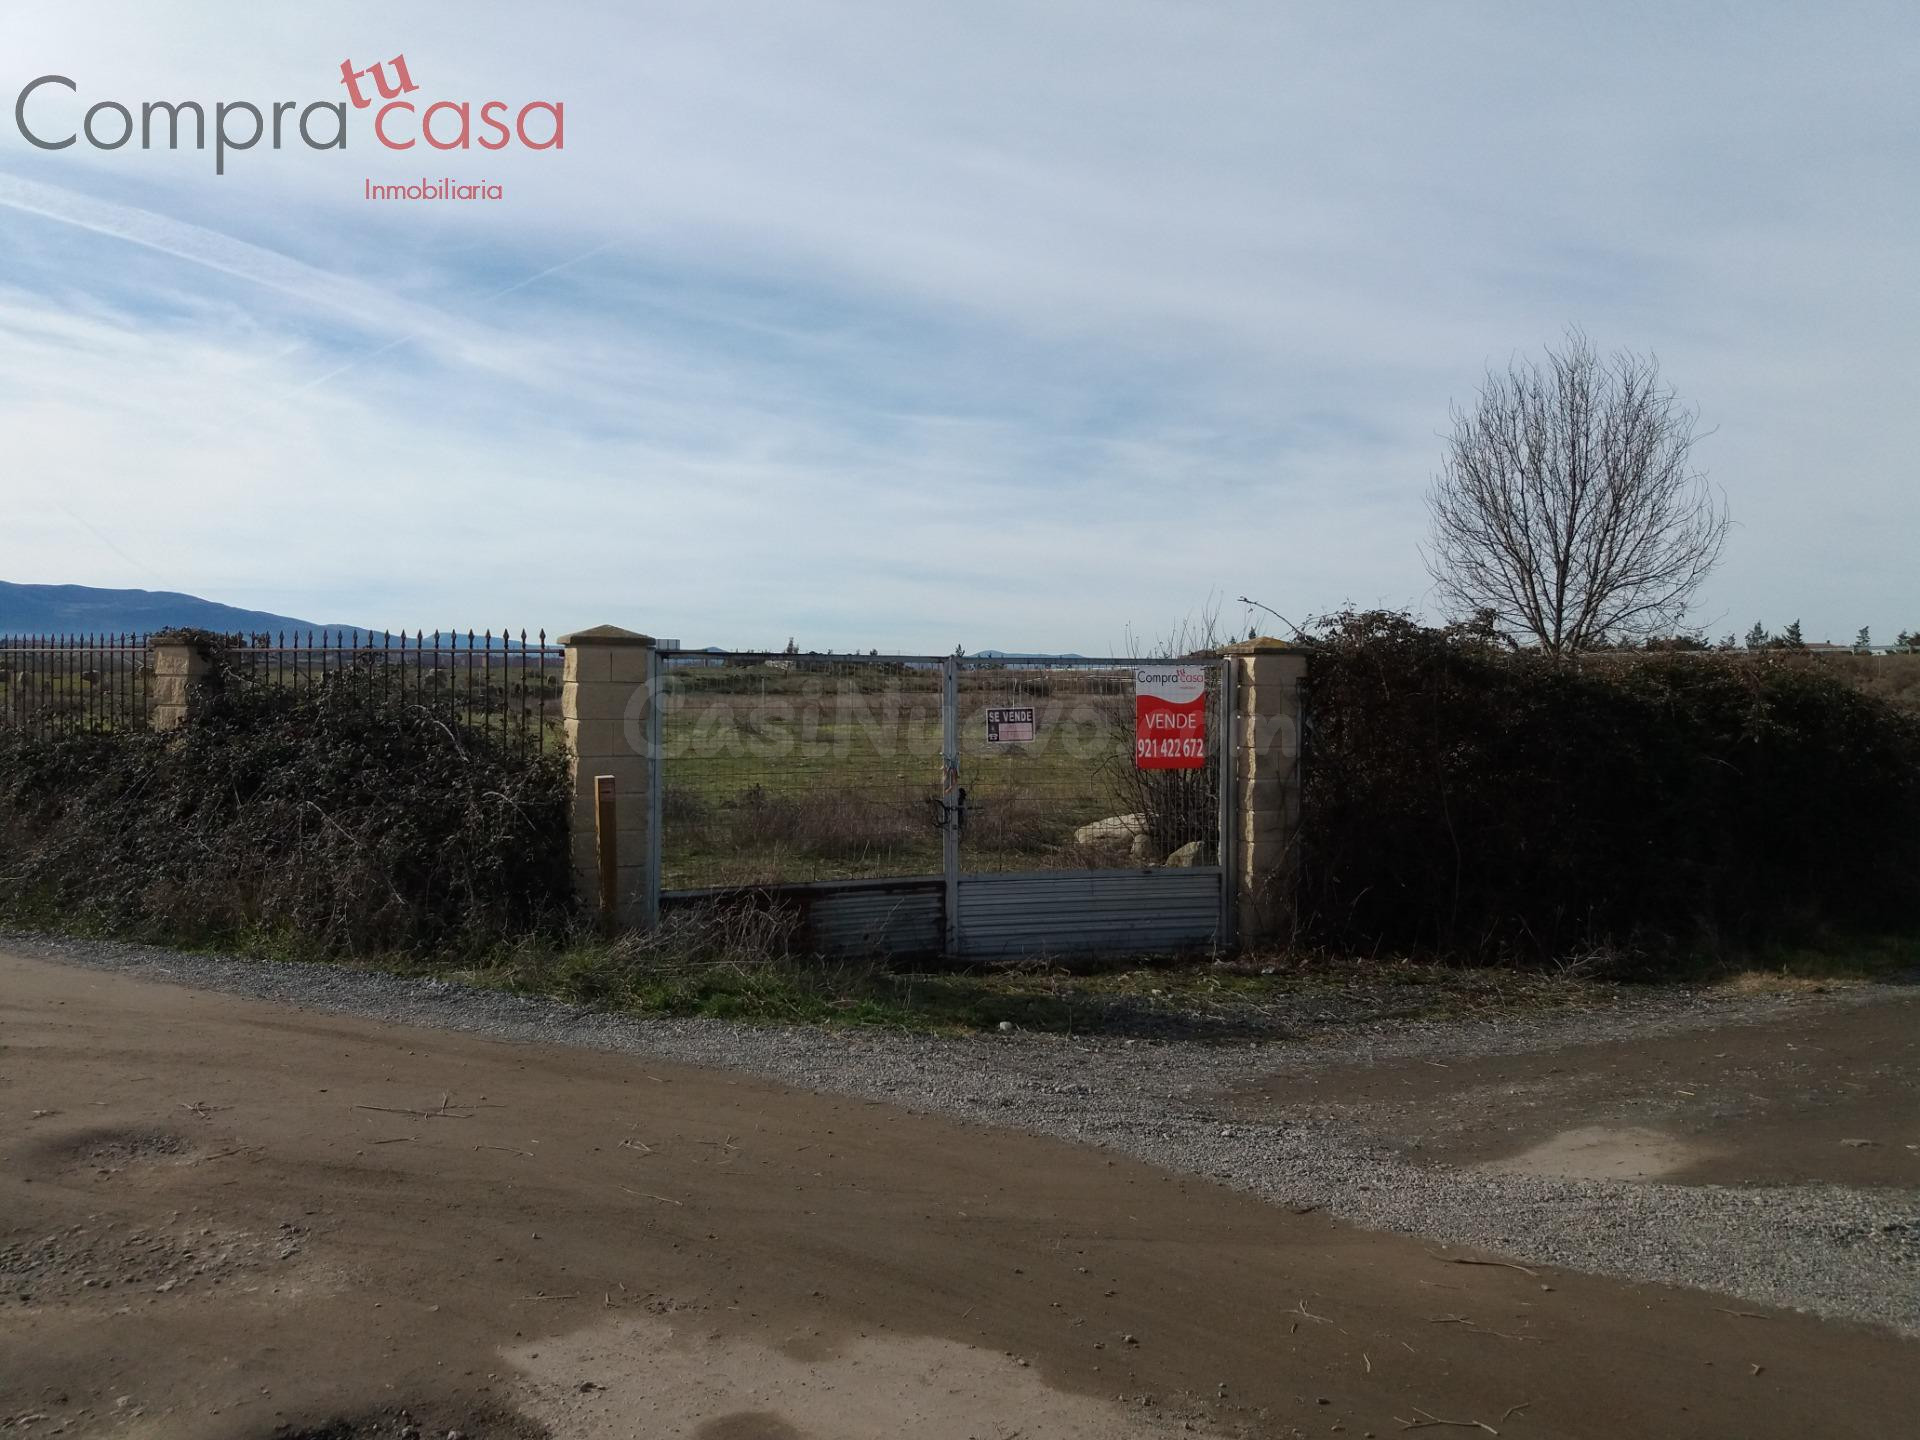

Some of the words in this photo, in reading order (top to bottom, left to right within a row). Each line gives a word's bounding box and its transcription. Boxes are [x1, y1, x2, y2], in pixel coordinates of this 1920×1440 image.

[1137, 670, 1178, 686] Compra
[989, 711, 1000, 722] SE
[1002, 711, 1032, 722] VENDE
[1145, 713, 1197, 729] VENDE
[1138, 739, 1157, 758] 921
[1160, 739, 1181, 758] 422
[1183, 739, 1204, 758] 672
